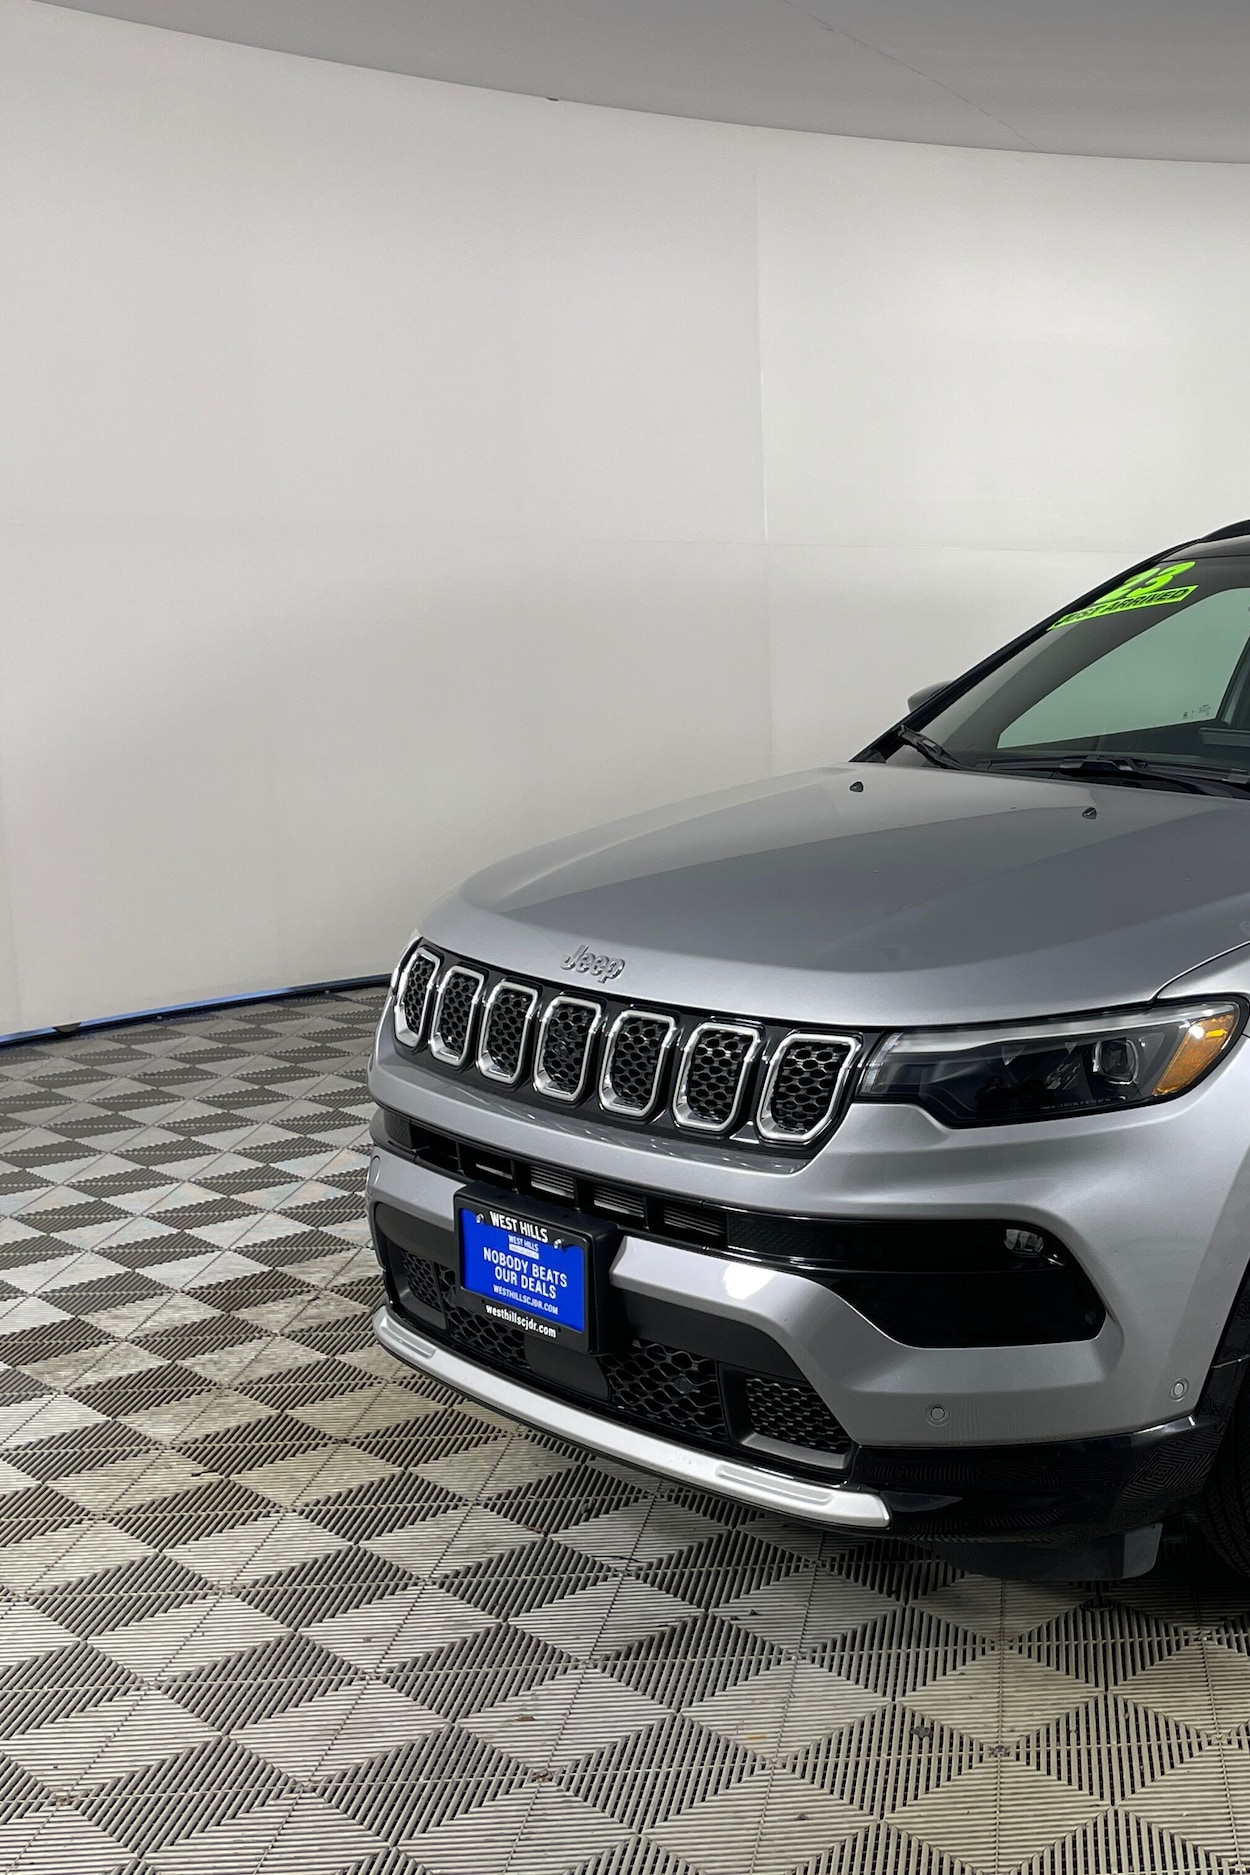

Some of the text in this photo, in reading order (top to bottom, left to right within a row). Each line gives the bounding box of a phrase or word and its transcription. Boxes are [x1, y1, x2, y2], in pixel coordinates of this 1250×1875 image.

[1105, 587, 1192, 612] ARRIVED
[560, 944, 626, 984] Jeep
[489, 1211, 549, 1243] WEST HILLS
[508, 1234, 524, 1246] WEST
[523, 1239, 539, 1253] HILLS
[483, 1246, 529, 1273] NOBODY
[531, 1263, 568, 1288] BEATS
[494, 1265, 557, 1299] OUR DEALS
[492, 1284, 559, 1315] WESTHILLSCJDR.COM
[485, 1304, 557, 1338] westhillscjdr.com
